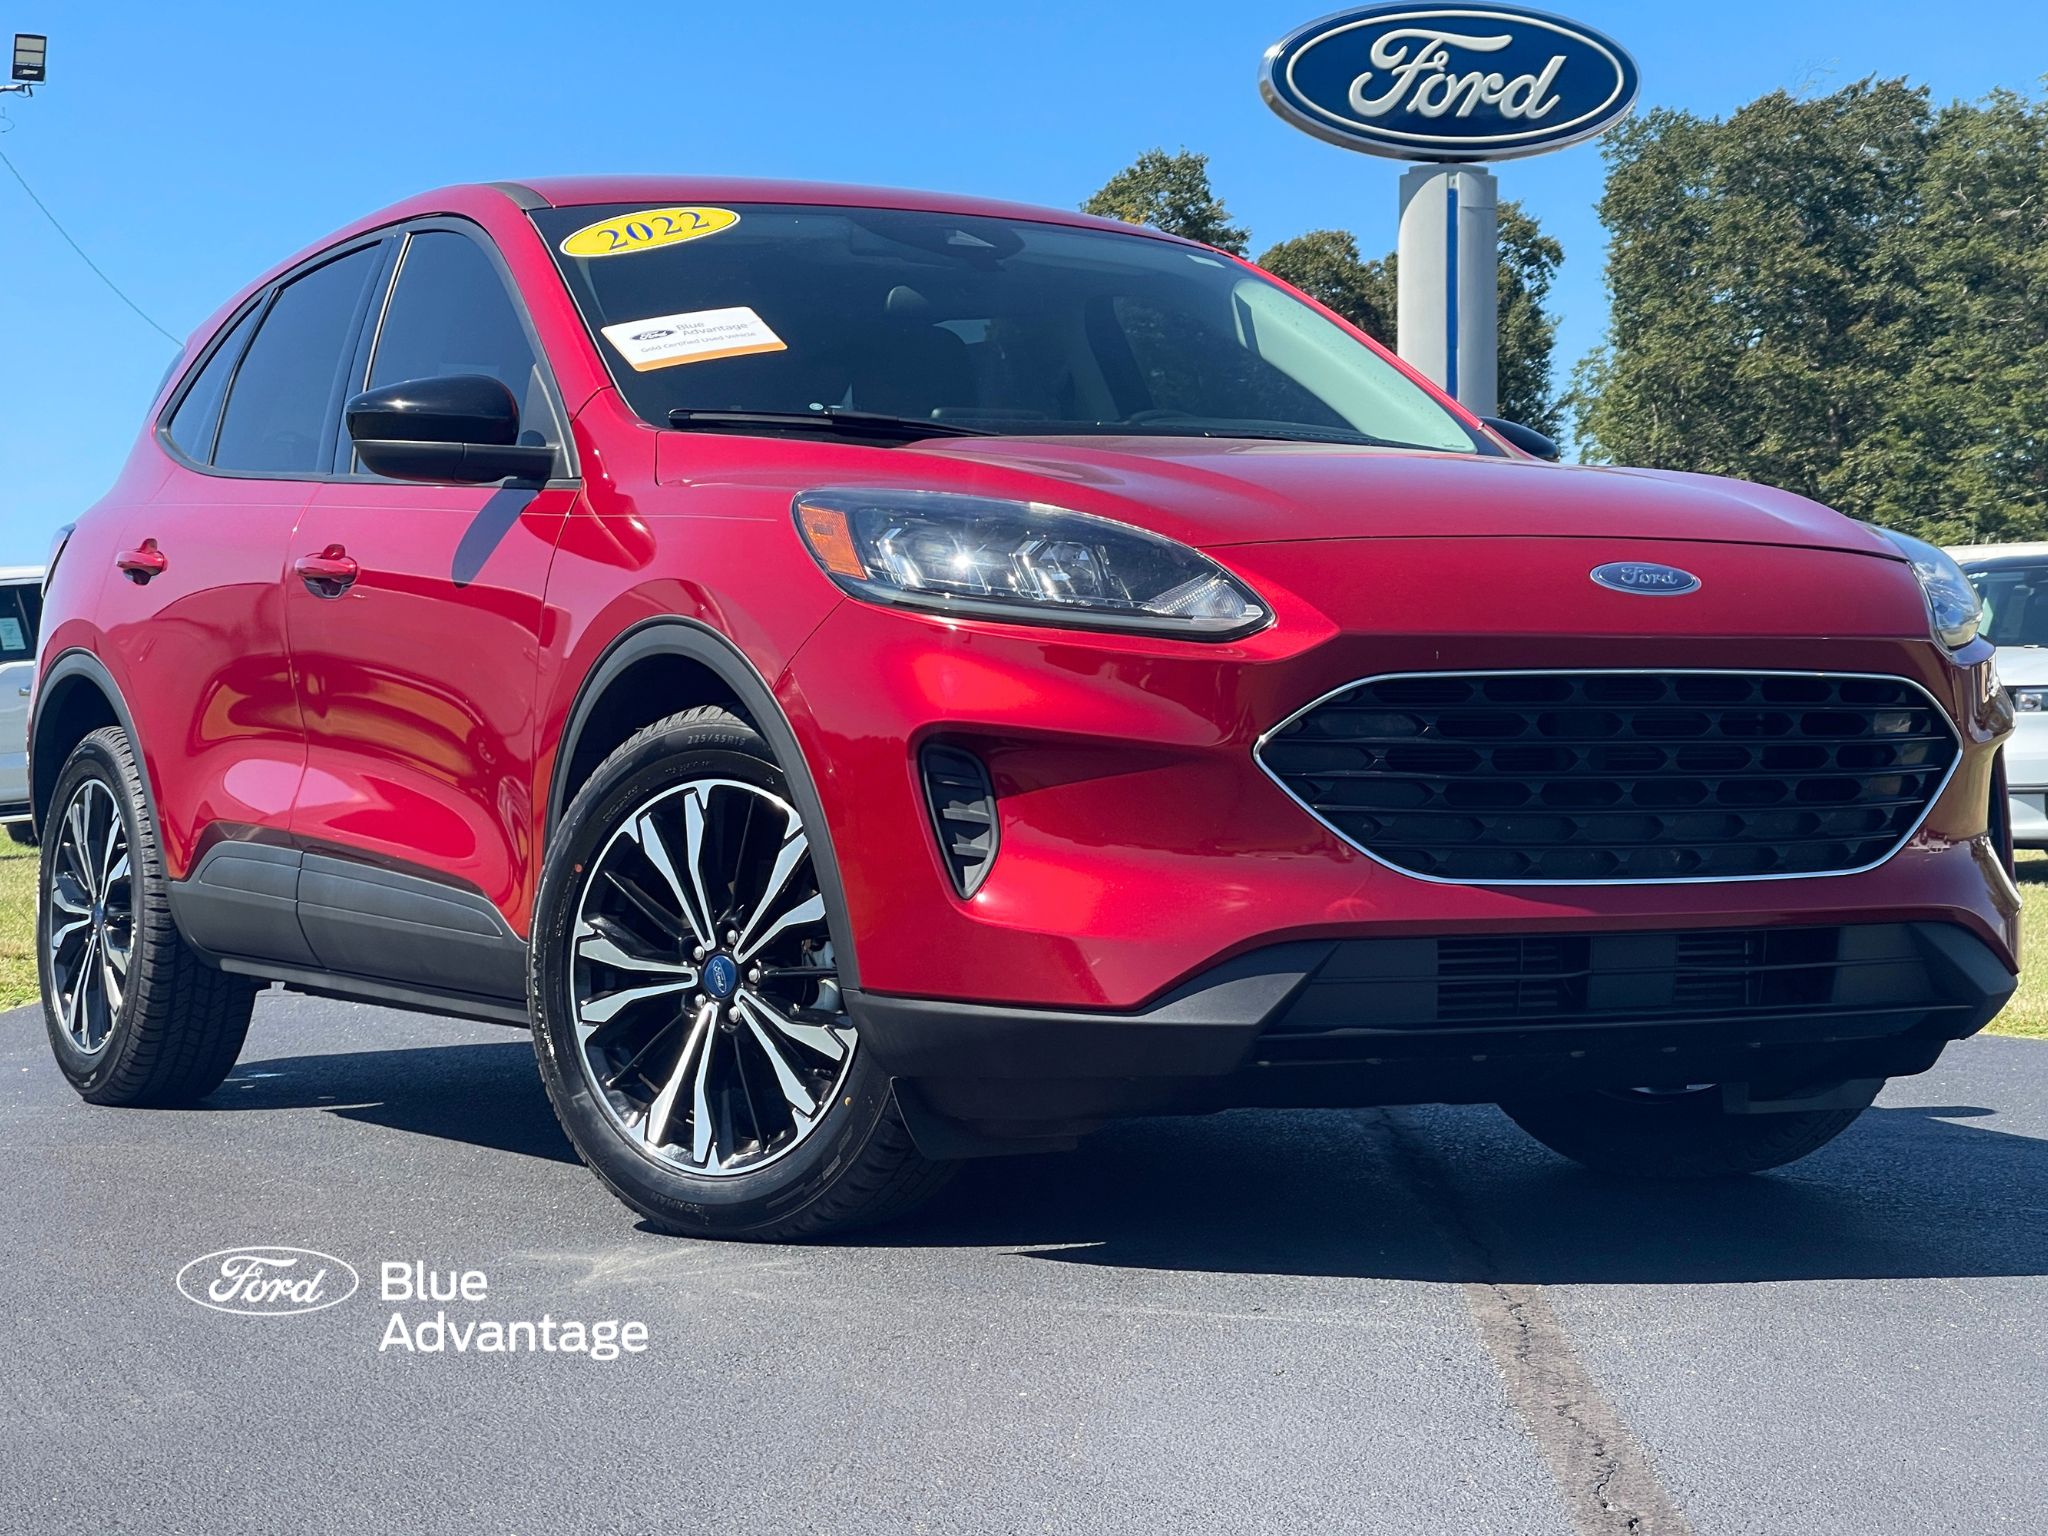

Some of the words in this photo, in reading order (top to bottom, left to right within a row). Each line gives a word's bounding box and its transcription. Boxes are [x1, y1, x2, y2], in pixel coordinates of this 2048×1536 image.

[1349, 28, 1567, 119] Ford
[597, 211, 710, 251] 2022
[676, 322, 704, 331] Blue
[683, 323, 748, 336] Advantage
[641, 345, 662, 353] Gold
[664, 339, 700, 349] Certified
[1621, 565, 1678, 585] Ford
